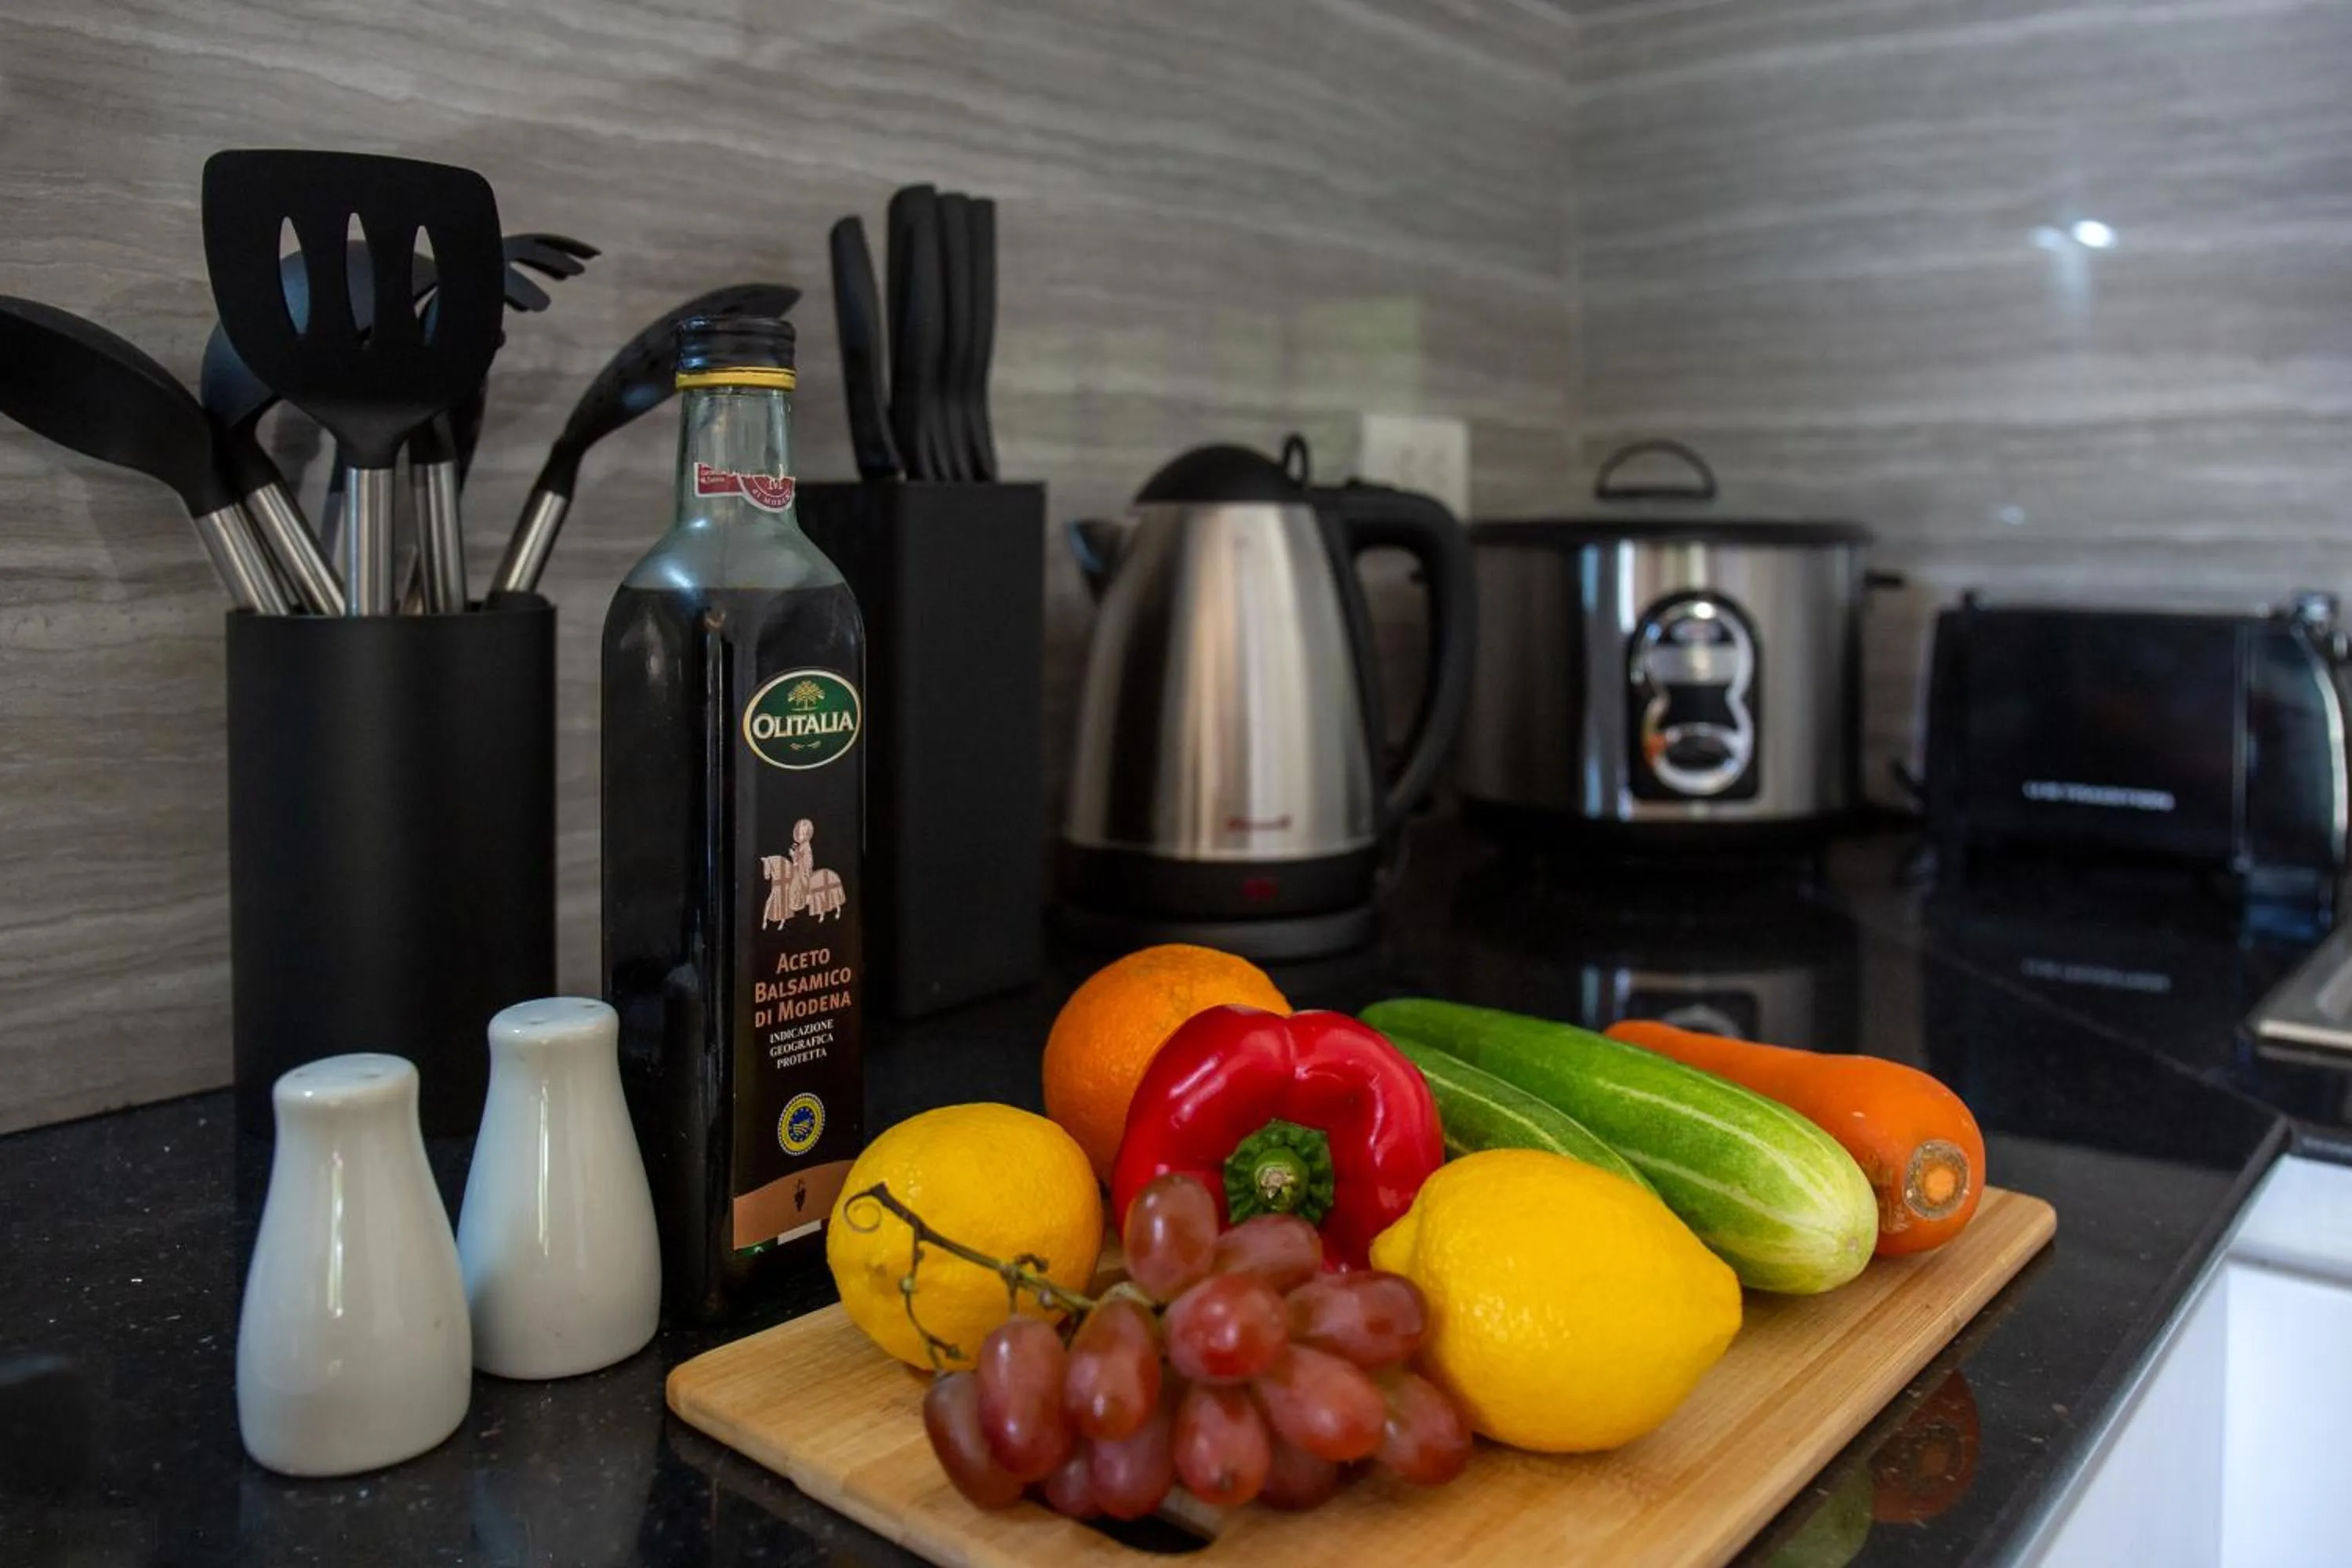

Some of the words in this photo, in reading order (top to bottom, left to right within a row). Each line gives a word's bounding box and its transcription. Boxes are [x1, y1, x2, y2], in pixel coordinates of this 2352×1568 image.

[752, 710, 855, 739] OLITALIA
[776, 948, 831, 974] ACETO
[755, 967, 851, 1004] BALSAMICO
[755, 1009, 772, 1028] DI
[778, 991, 851, 1022] MODENA
[769, 1018, 834, 1044] INDICAZIONE
[769, 1033, 834, 1058] GEOGRAFICA
[777, 1047, 827, 1069] PROTETTA
